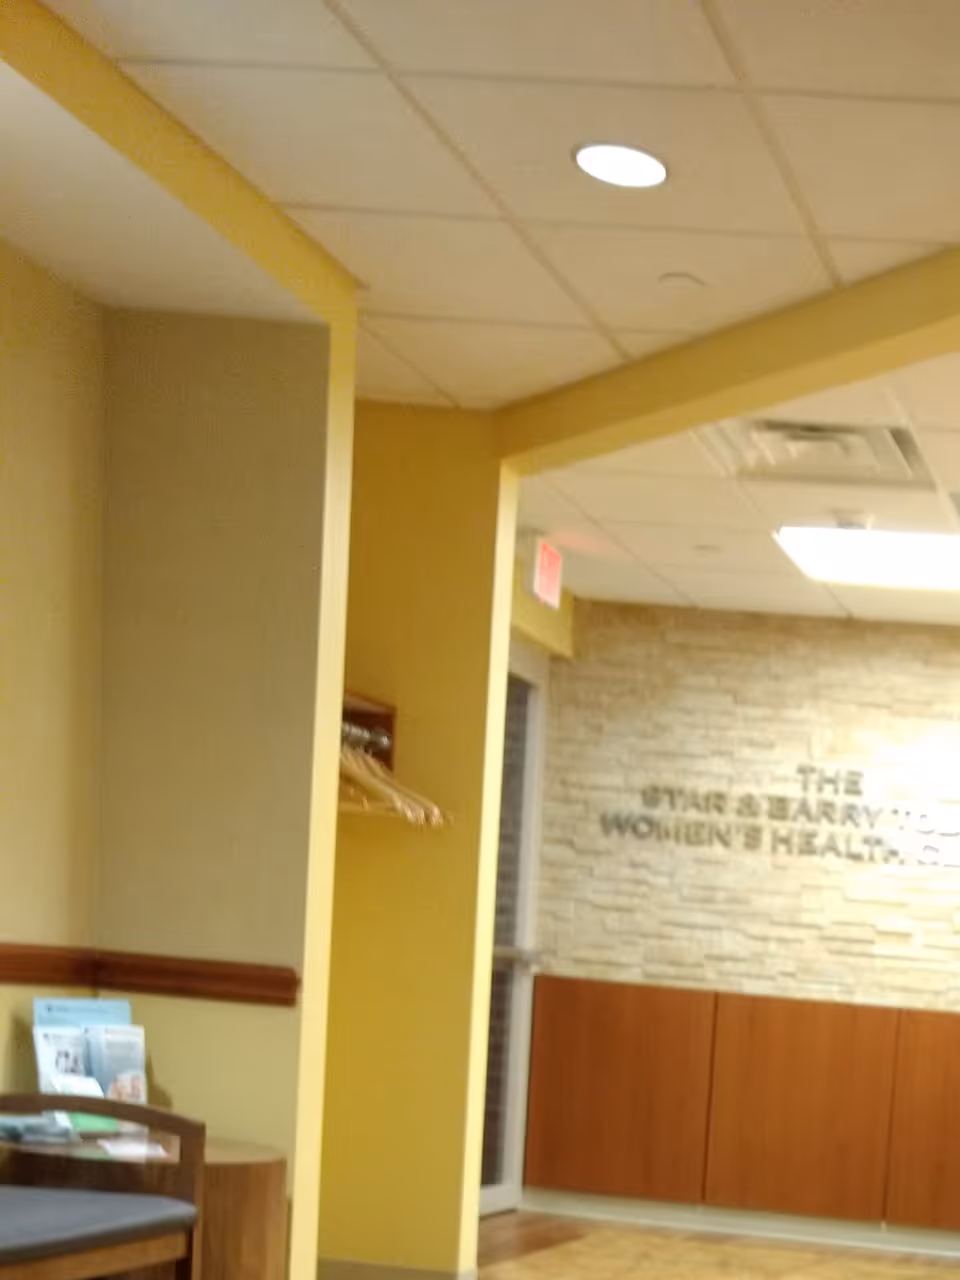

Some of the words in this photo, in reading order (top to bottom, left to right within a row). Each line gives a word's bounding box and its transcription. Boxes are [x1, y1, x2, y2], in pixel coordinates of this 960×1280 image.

[796, 764, 865, 797] THE
[641, 784, 726, 815] STAR
[736, 792, 761, 818] &
[768, 795, 884, 831] BARRY
[599, 811, 763, 851] WOMEN'S
